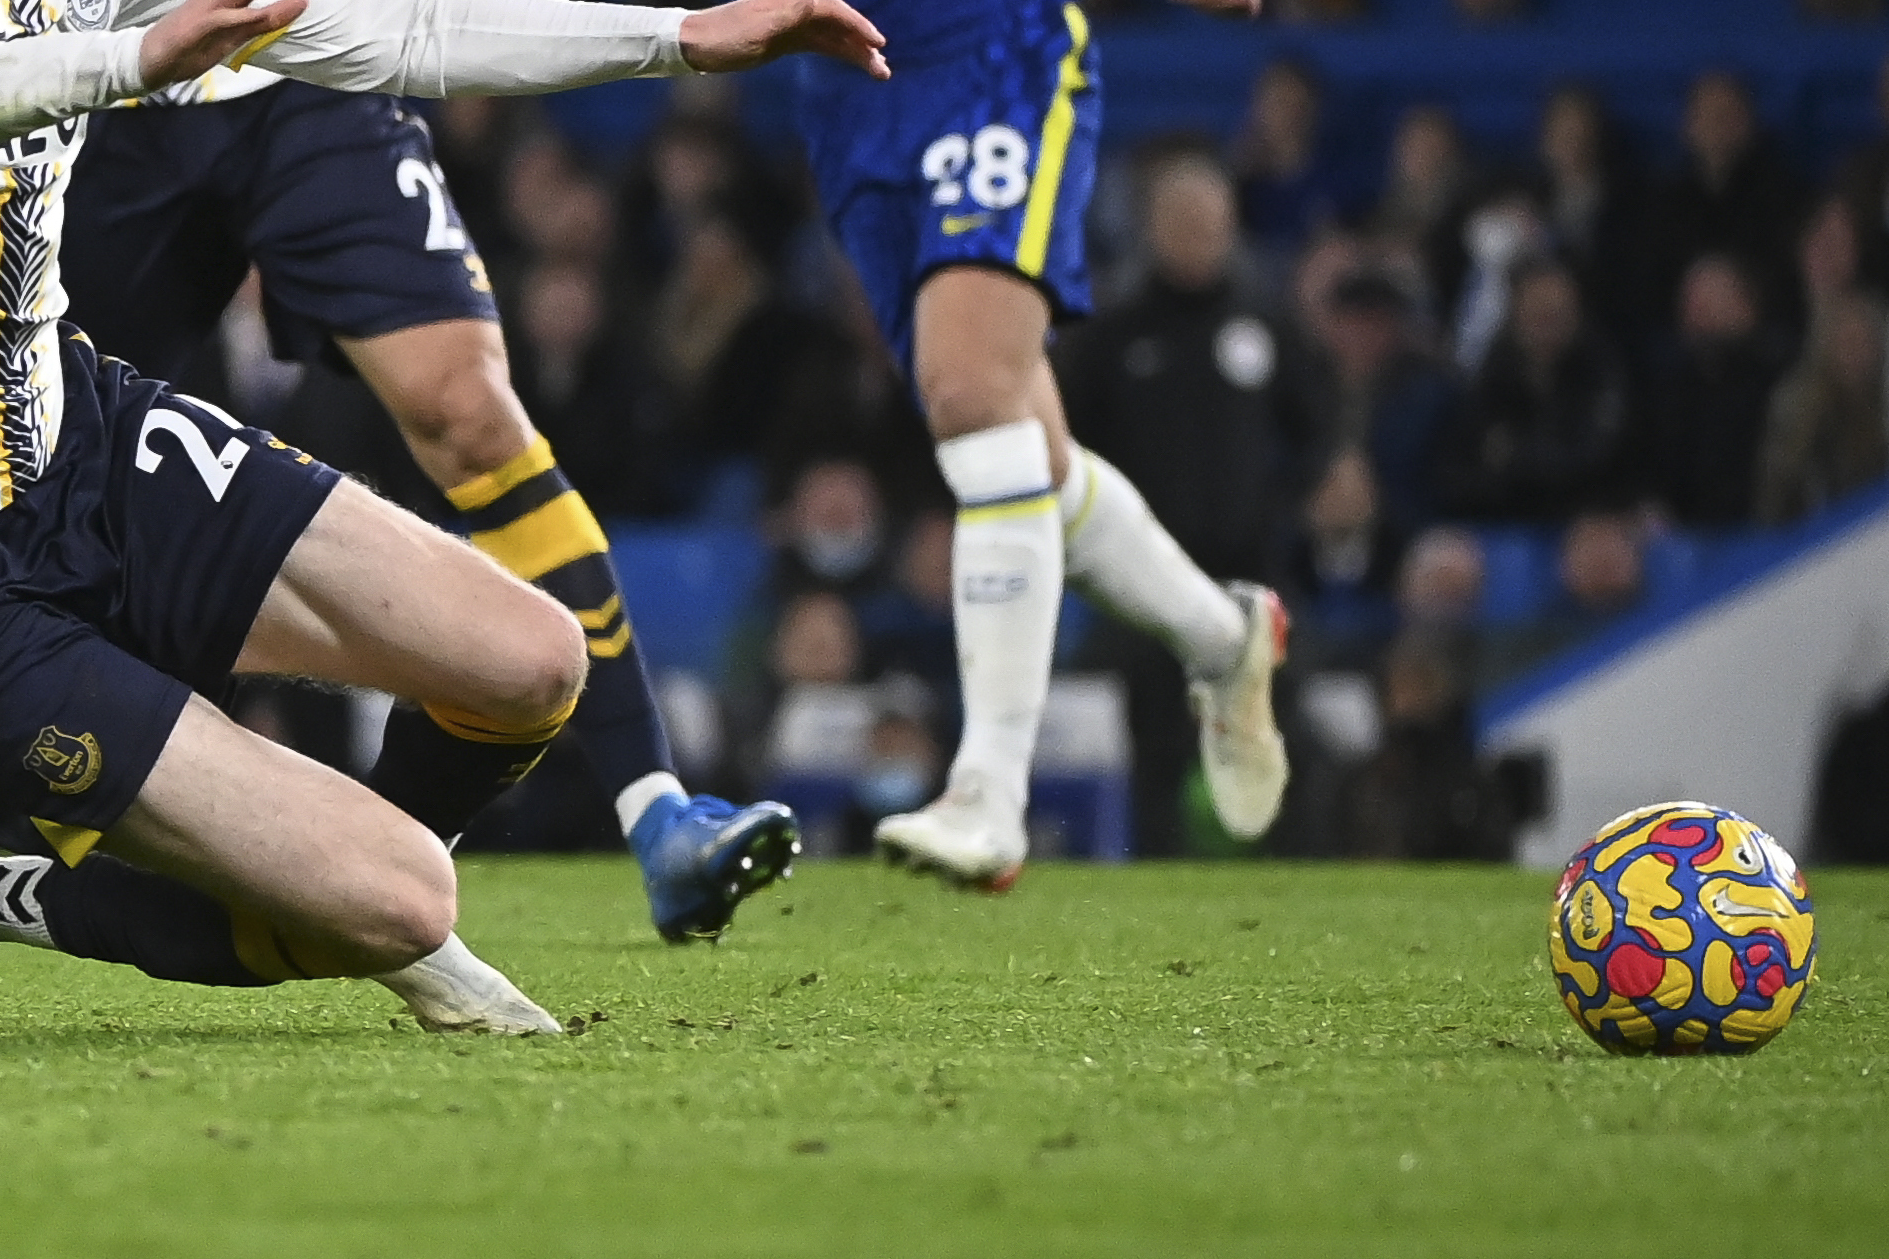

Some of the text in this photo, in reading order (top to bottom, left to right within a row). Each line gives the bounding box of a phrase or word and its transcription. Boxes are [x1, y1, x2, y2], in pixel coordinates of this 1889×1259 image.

[396, 157, 465, 251] 2
[921, 124, 1029, 210] 28
[135, 394, 251, 503] 2
